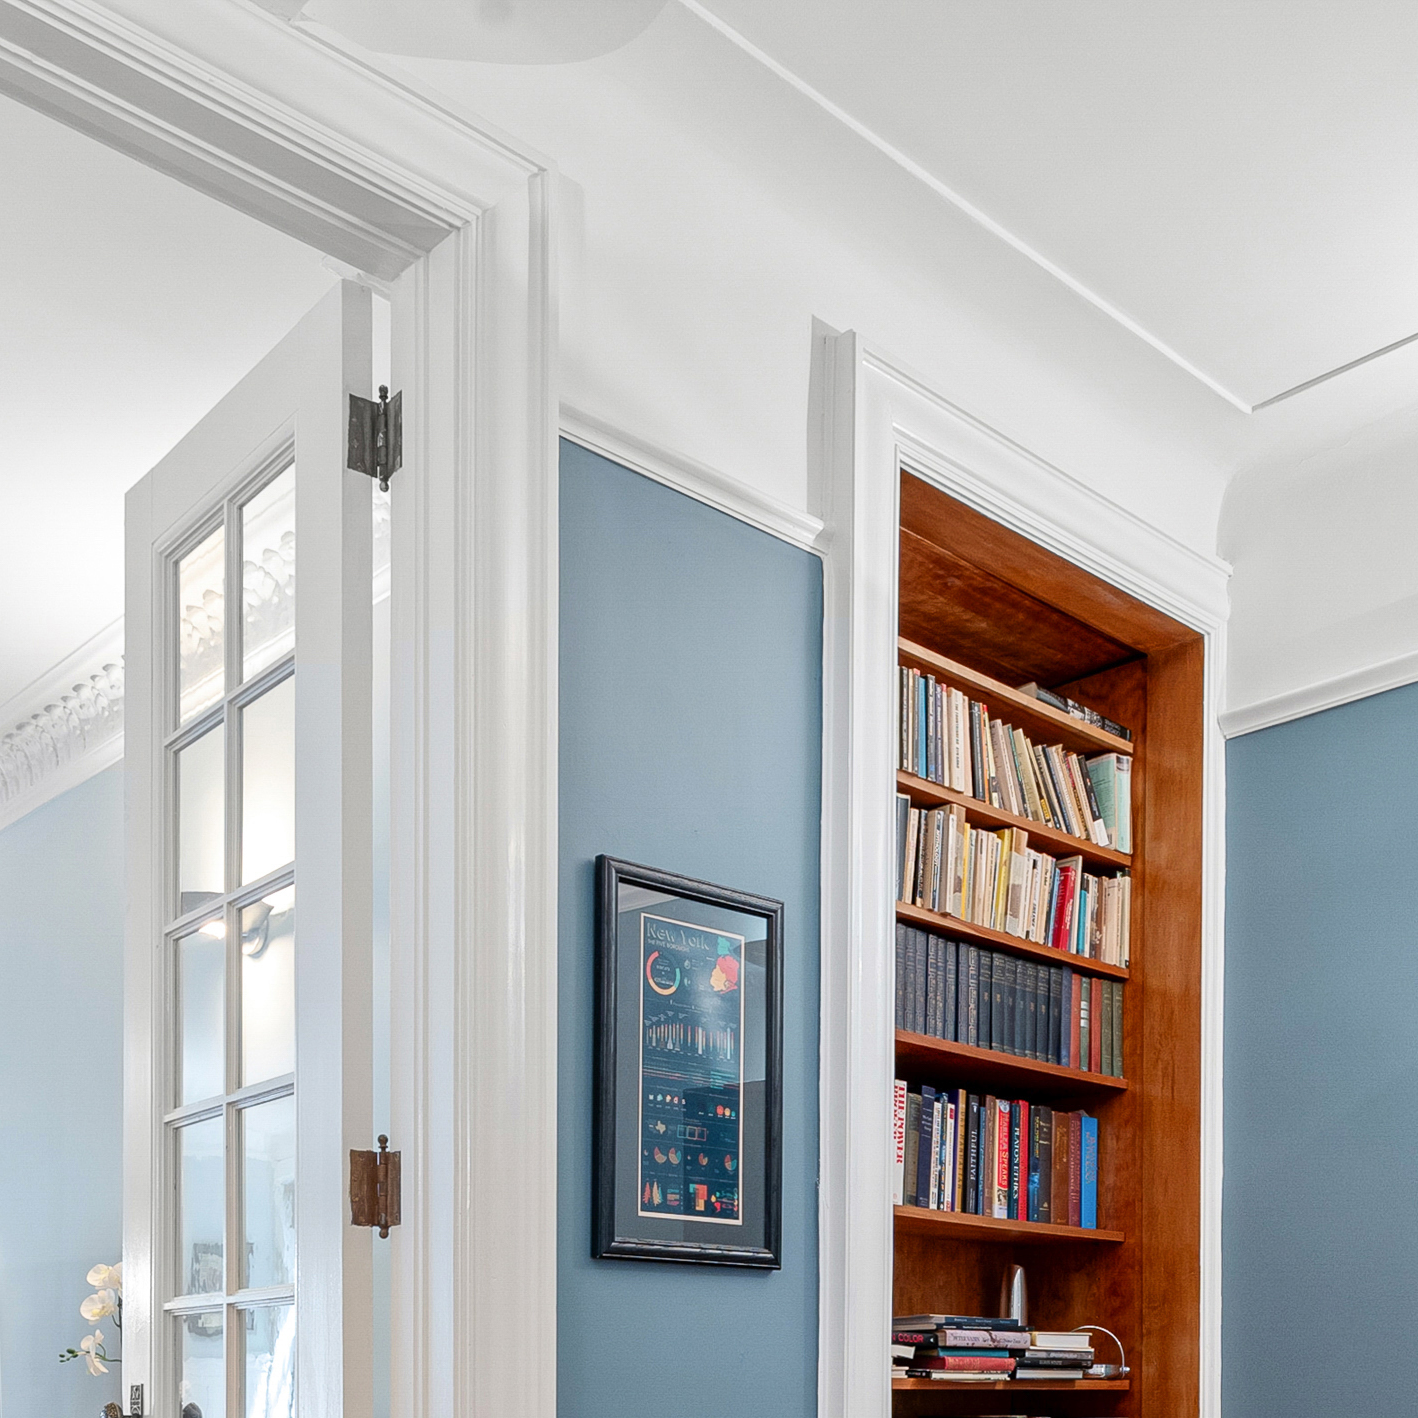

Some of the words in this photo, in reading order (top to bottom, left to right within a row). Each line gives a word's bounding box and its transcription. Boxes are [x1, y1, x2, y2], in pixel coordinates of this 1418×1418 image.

[646, 922, 675, 942] New
[680, 930, 710, 950] York
[896, 1118, 904, 1164] POWER
[898, 1333, 924, 1343] COLOR
